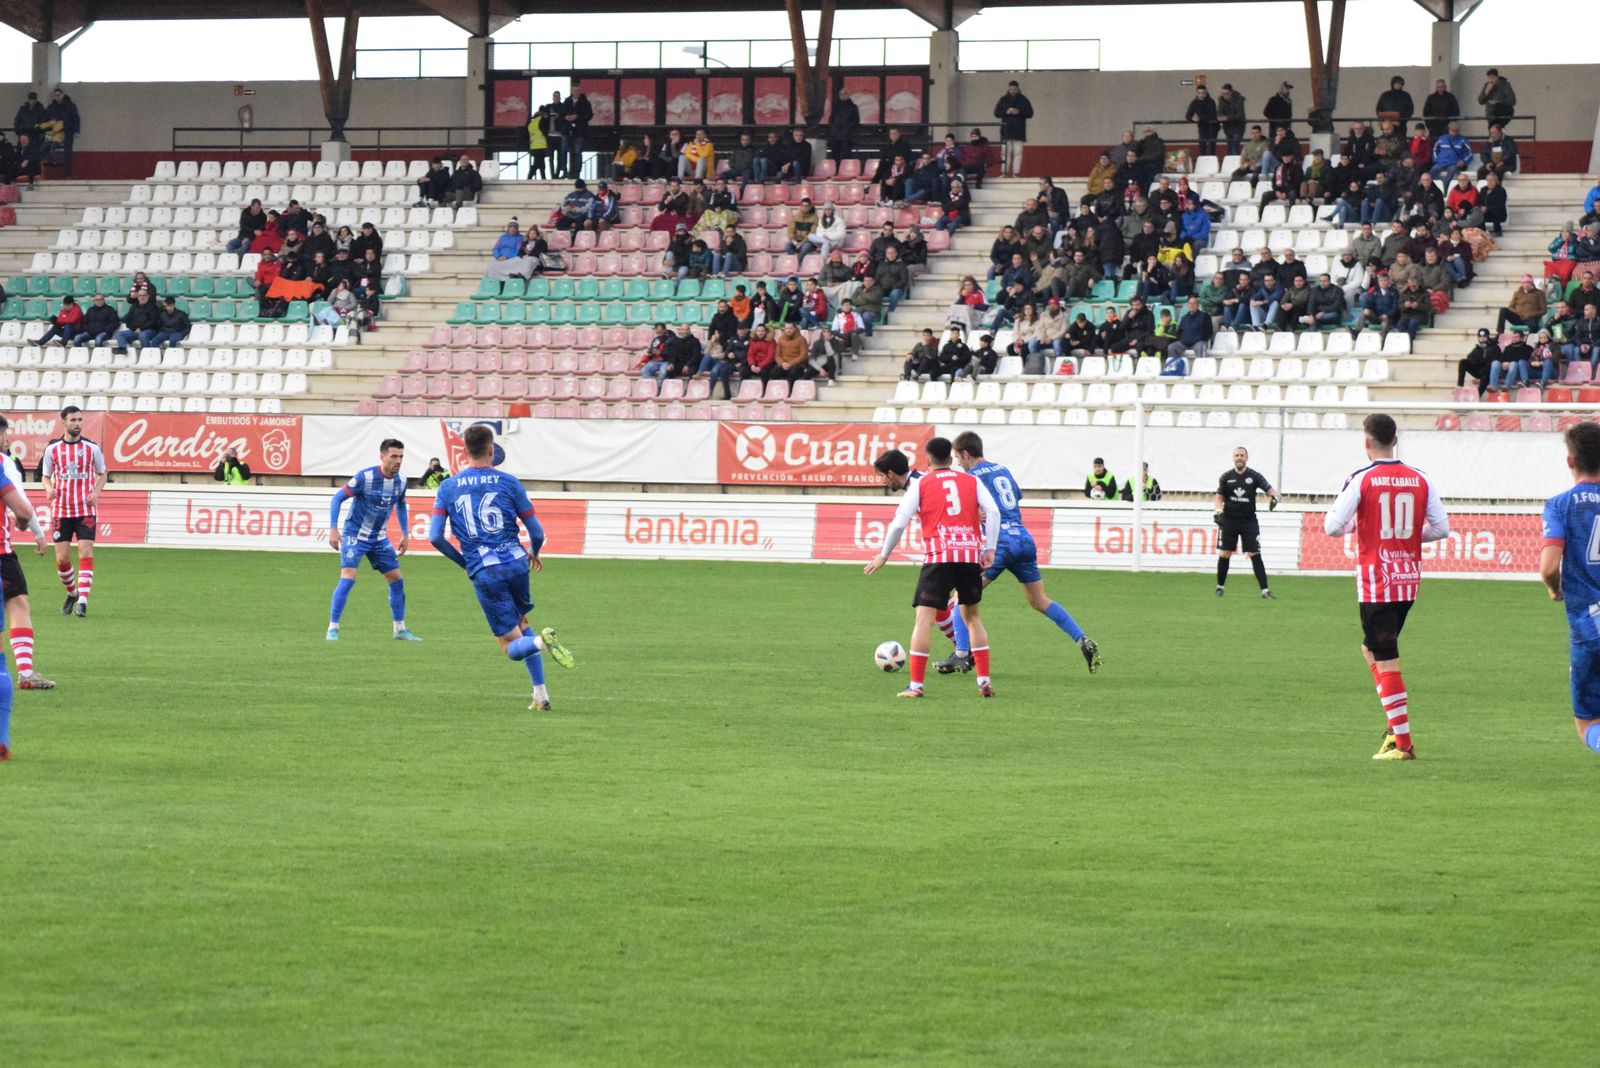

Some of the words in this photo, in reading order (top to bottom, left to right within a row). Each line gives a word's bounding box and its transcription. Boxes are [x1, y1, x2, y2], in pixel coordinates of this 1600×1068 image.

[206, 416, 250, 426] EMBUTIDOS
[251, 417, 257, 425] Y
[259, 417, 297, 426] JAMONES
[113, 419, 251, 470] Cardiza
[457, 476, 478, 487] JAVI
[481, 475, 500, 485] REY
[942, 480, 961, 516] 3
[993, 476, 1016, 510] 8
[1370, 476, 1391, 487] MARC
[1391, 475, 1420, 487] CABALLÉ
[186, 498, 313, 537] lantania
[454, 492, 504, 538] 16
[625, 507, 759, 546] lantania
[1378, 492, 1415, 539] 10
[346, 535, 358, 546] 19
